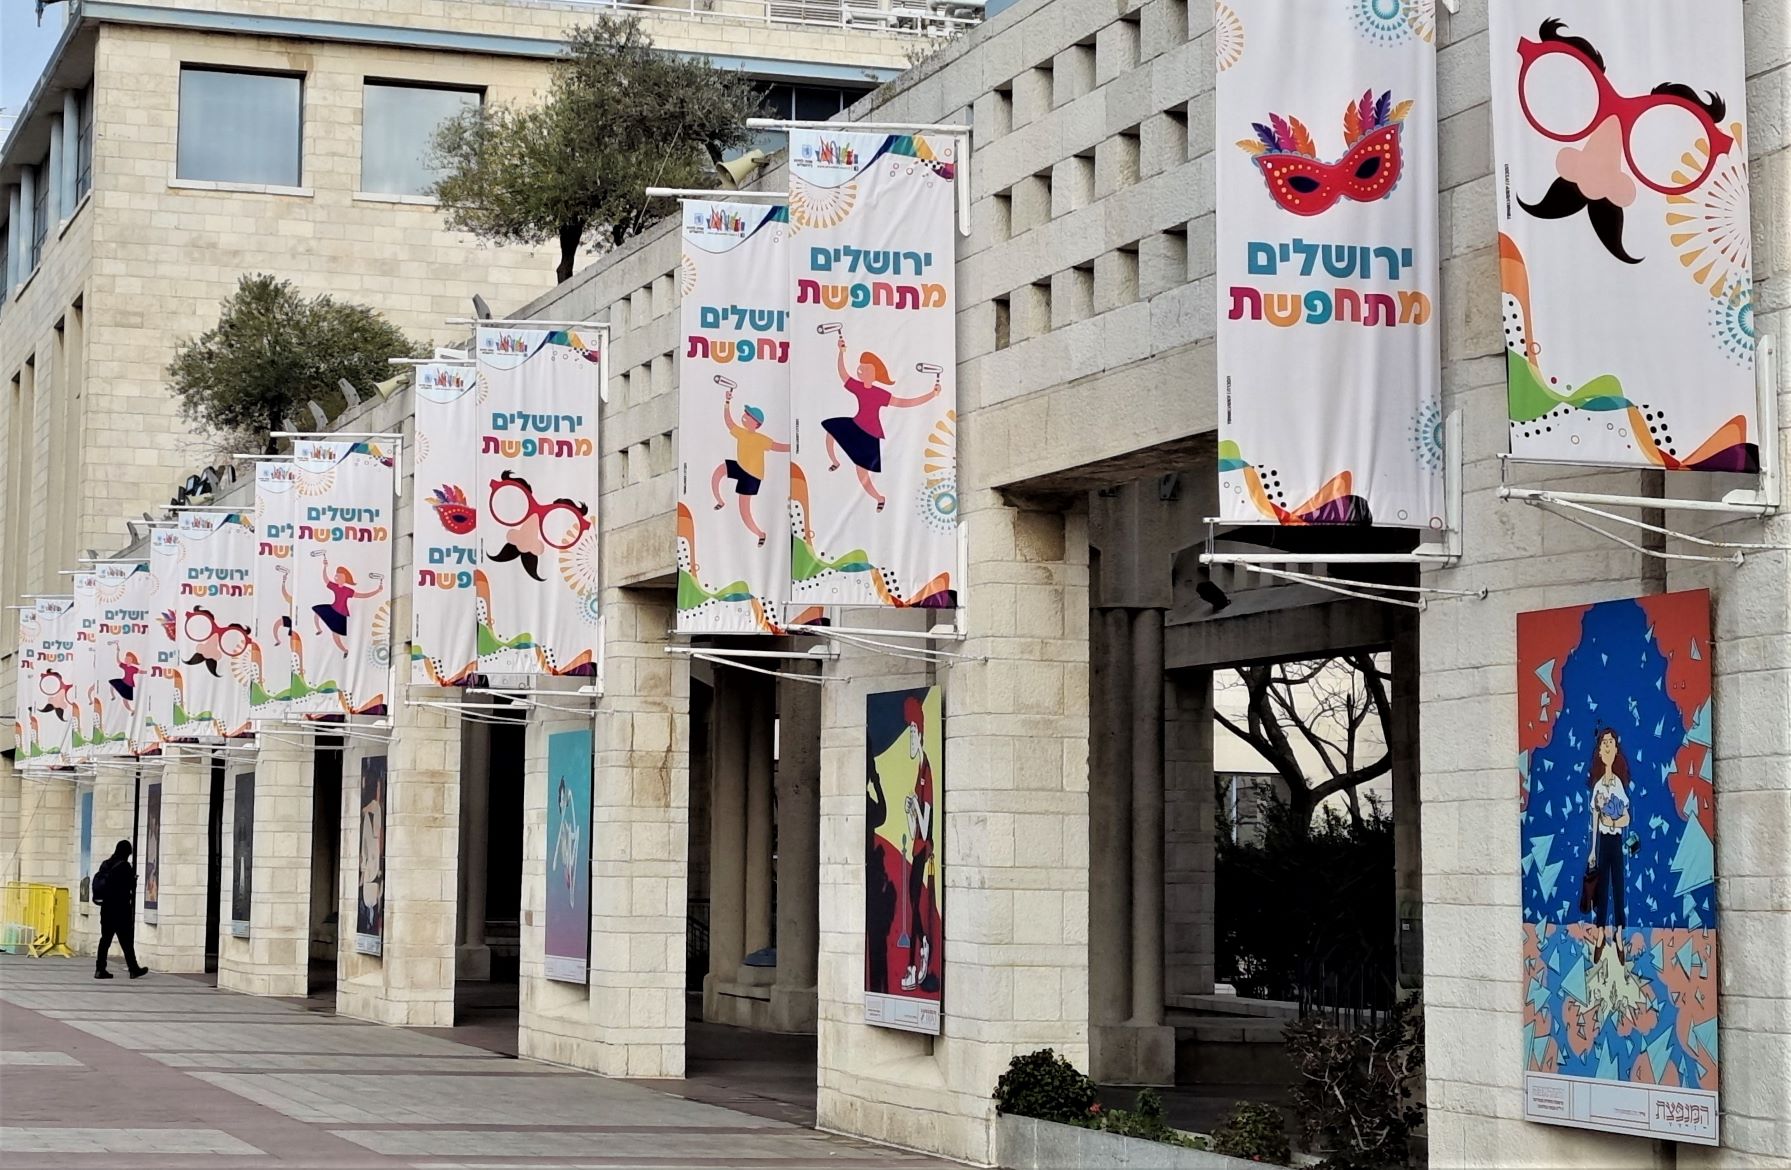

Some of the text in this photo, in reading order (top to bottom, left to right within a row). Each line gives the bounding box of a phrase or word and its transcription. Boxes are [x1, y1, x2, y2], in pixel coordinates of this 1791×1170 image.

[811, 245, 932, 276] ירושלים
[1248, 238, 1412, 280] ירושלים
[797, 279, 946, 310] מתחפשת
[1228, 287, 1431, 327] מתחפשת
[700, 305, 789, 332] ושלים
[492, 411, 582, 433] ירושלים
[482, 436, 592, 458] מתחפשת
[307, 505, 380, 522] ירושלים
[299, 525, 388, 542] מתחפשת
[188, 566, 249, 580] ירושלים
[180, 583, 253, 597] מתחפשת
[42, 640, 73, 650] שלים
[37, 652, 73, 662] חפשת
